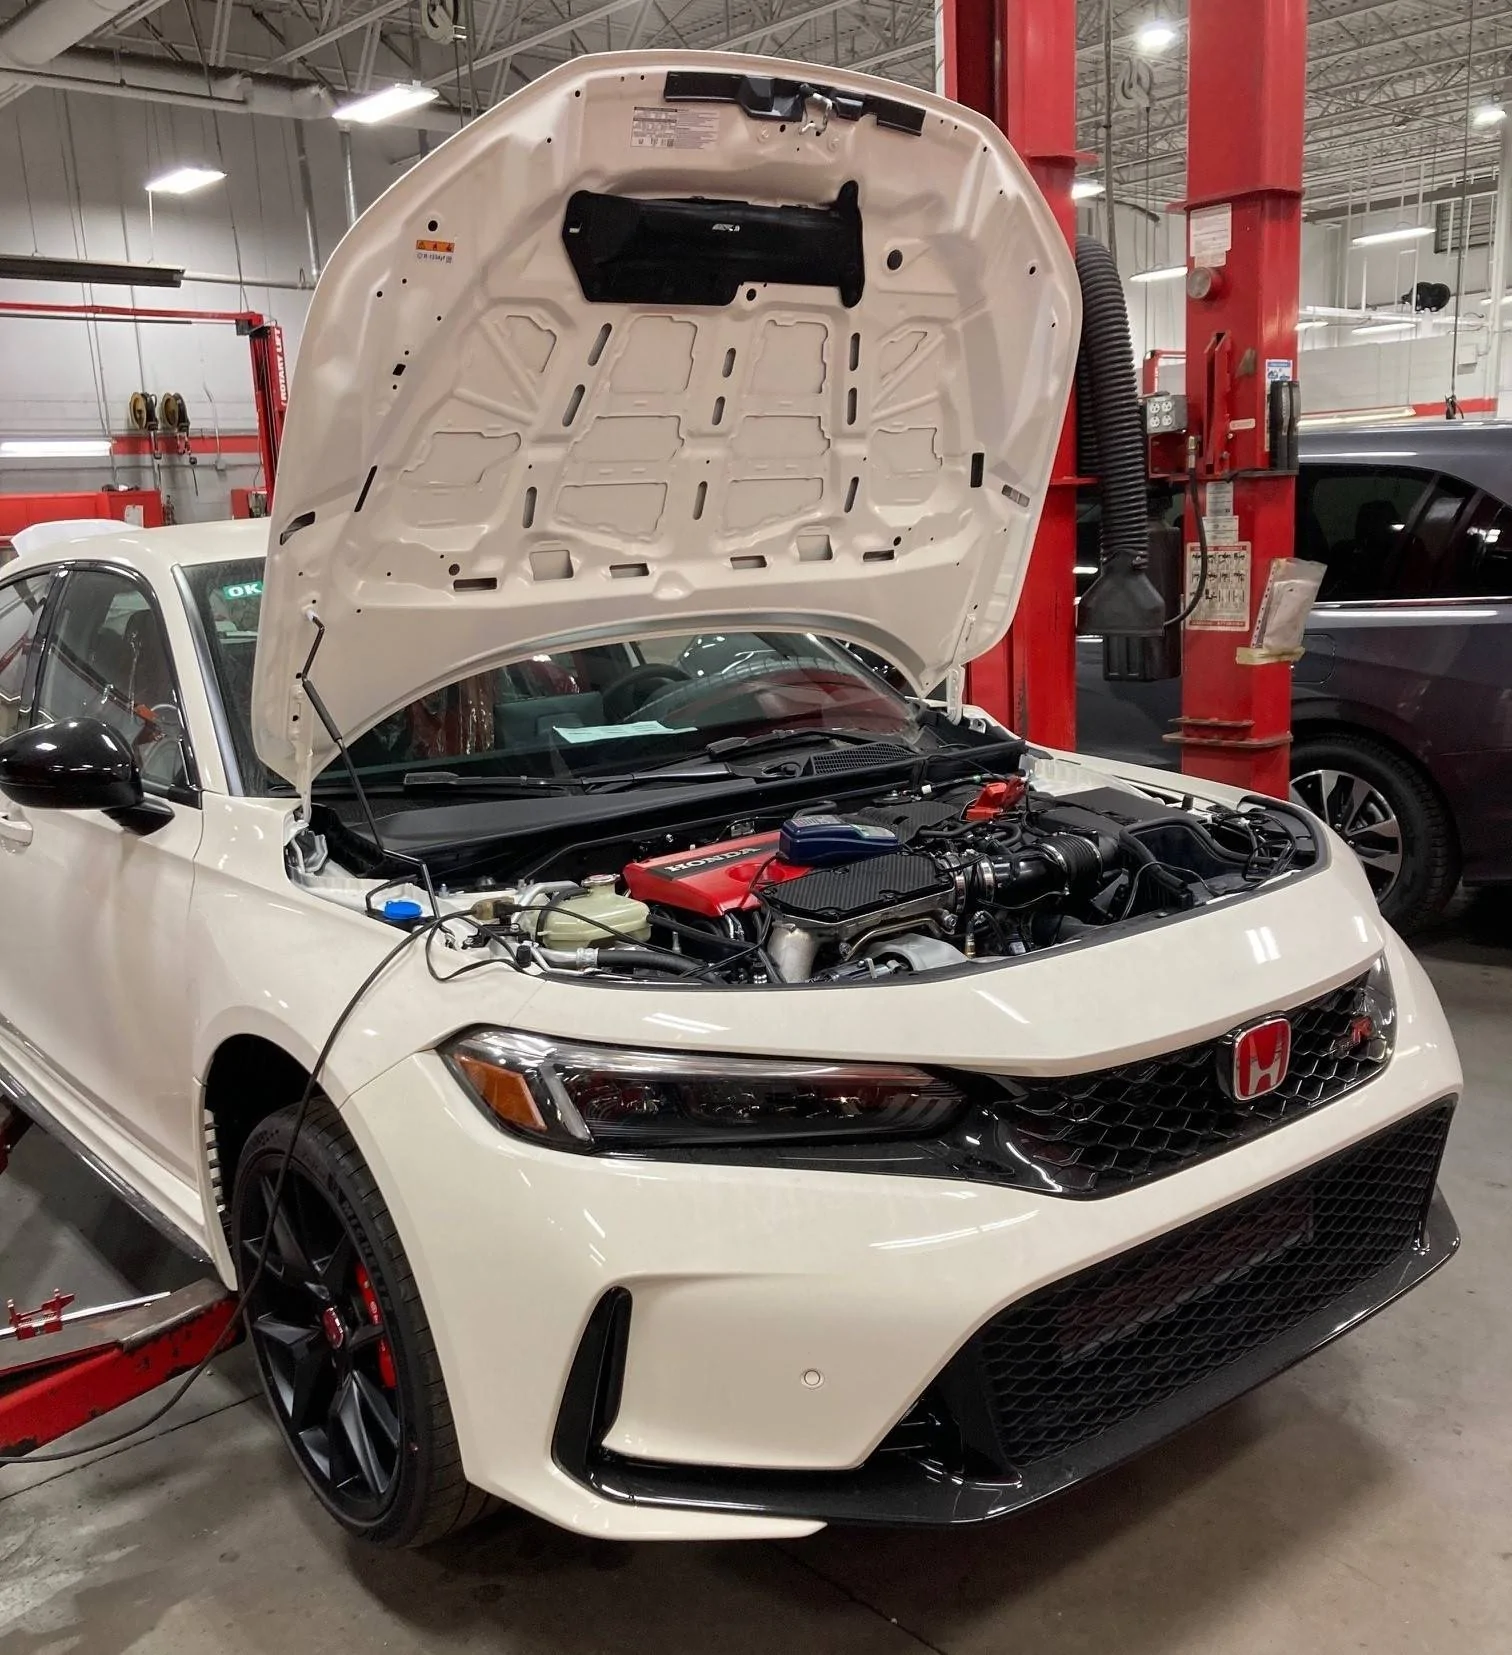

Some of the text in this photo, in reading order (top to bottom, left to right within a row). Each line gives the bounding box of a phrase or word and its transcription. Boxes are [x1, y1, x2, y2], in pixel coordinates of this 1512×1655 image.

[274, 327, 287, 402] ROTARY LIFT
[228, 583, 262, 597] OK
[664, 847, 761, 872] HONDA
